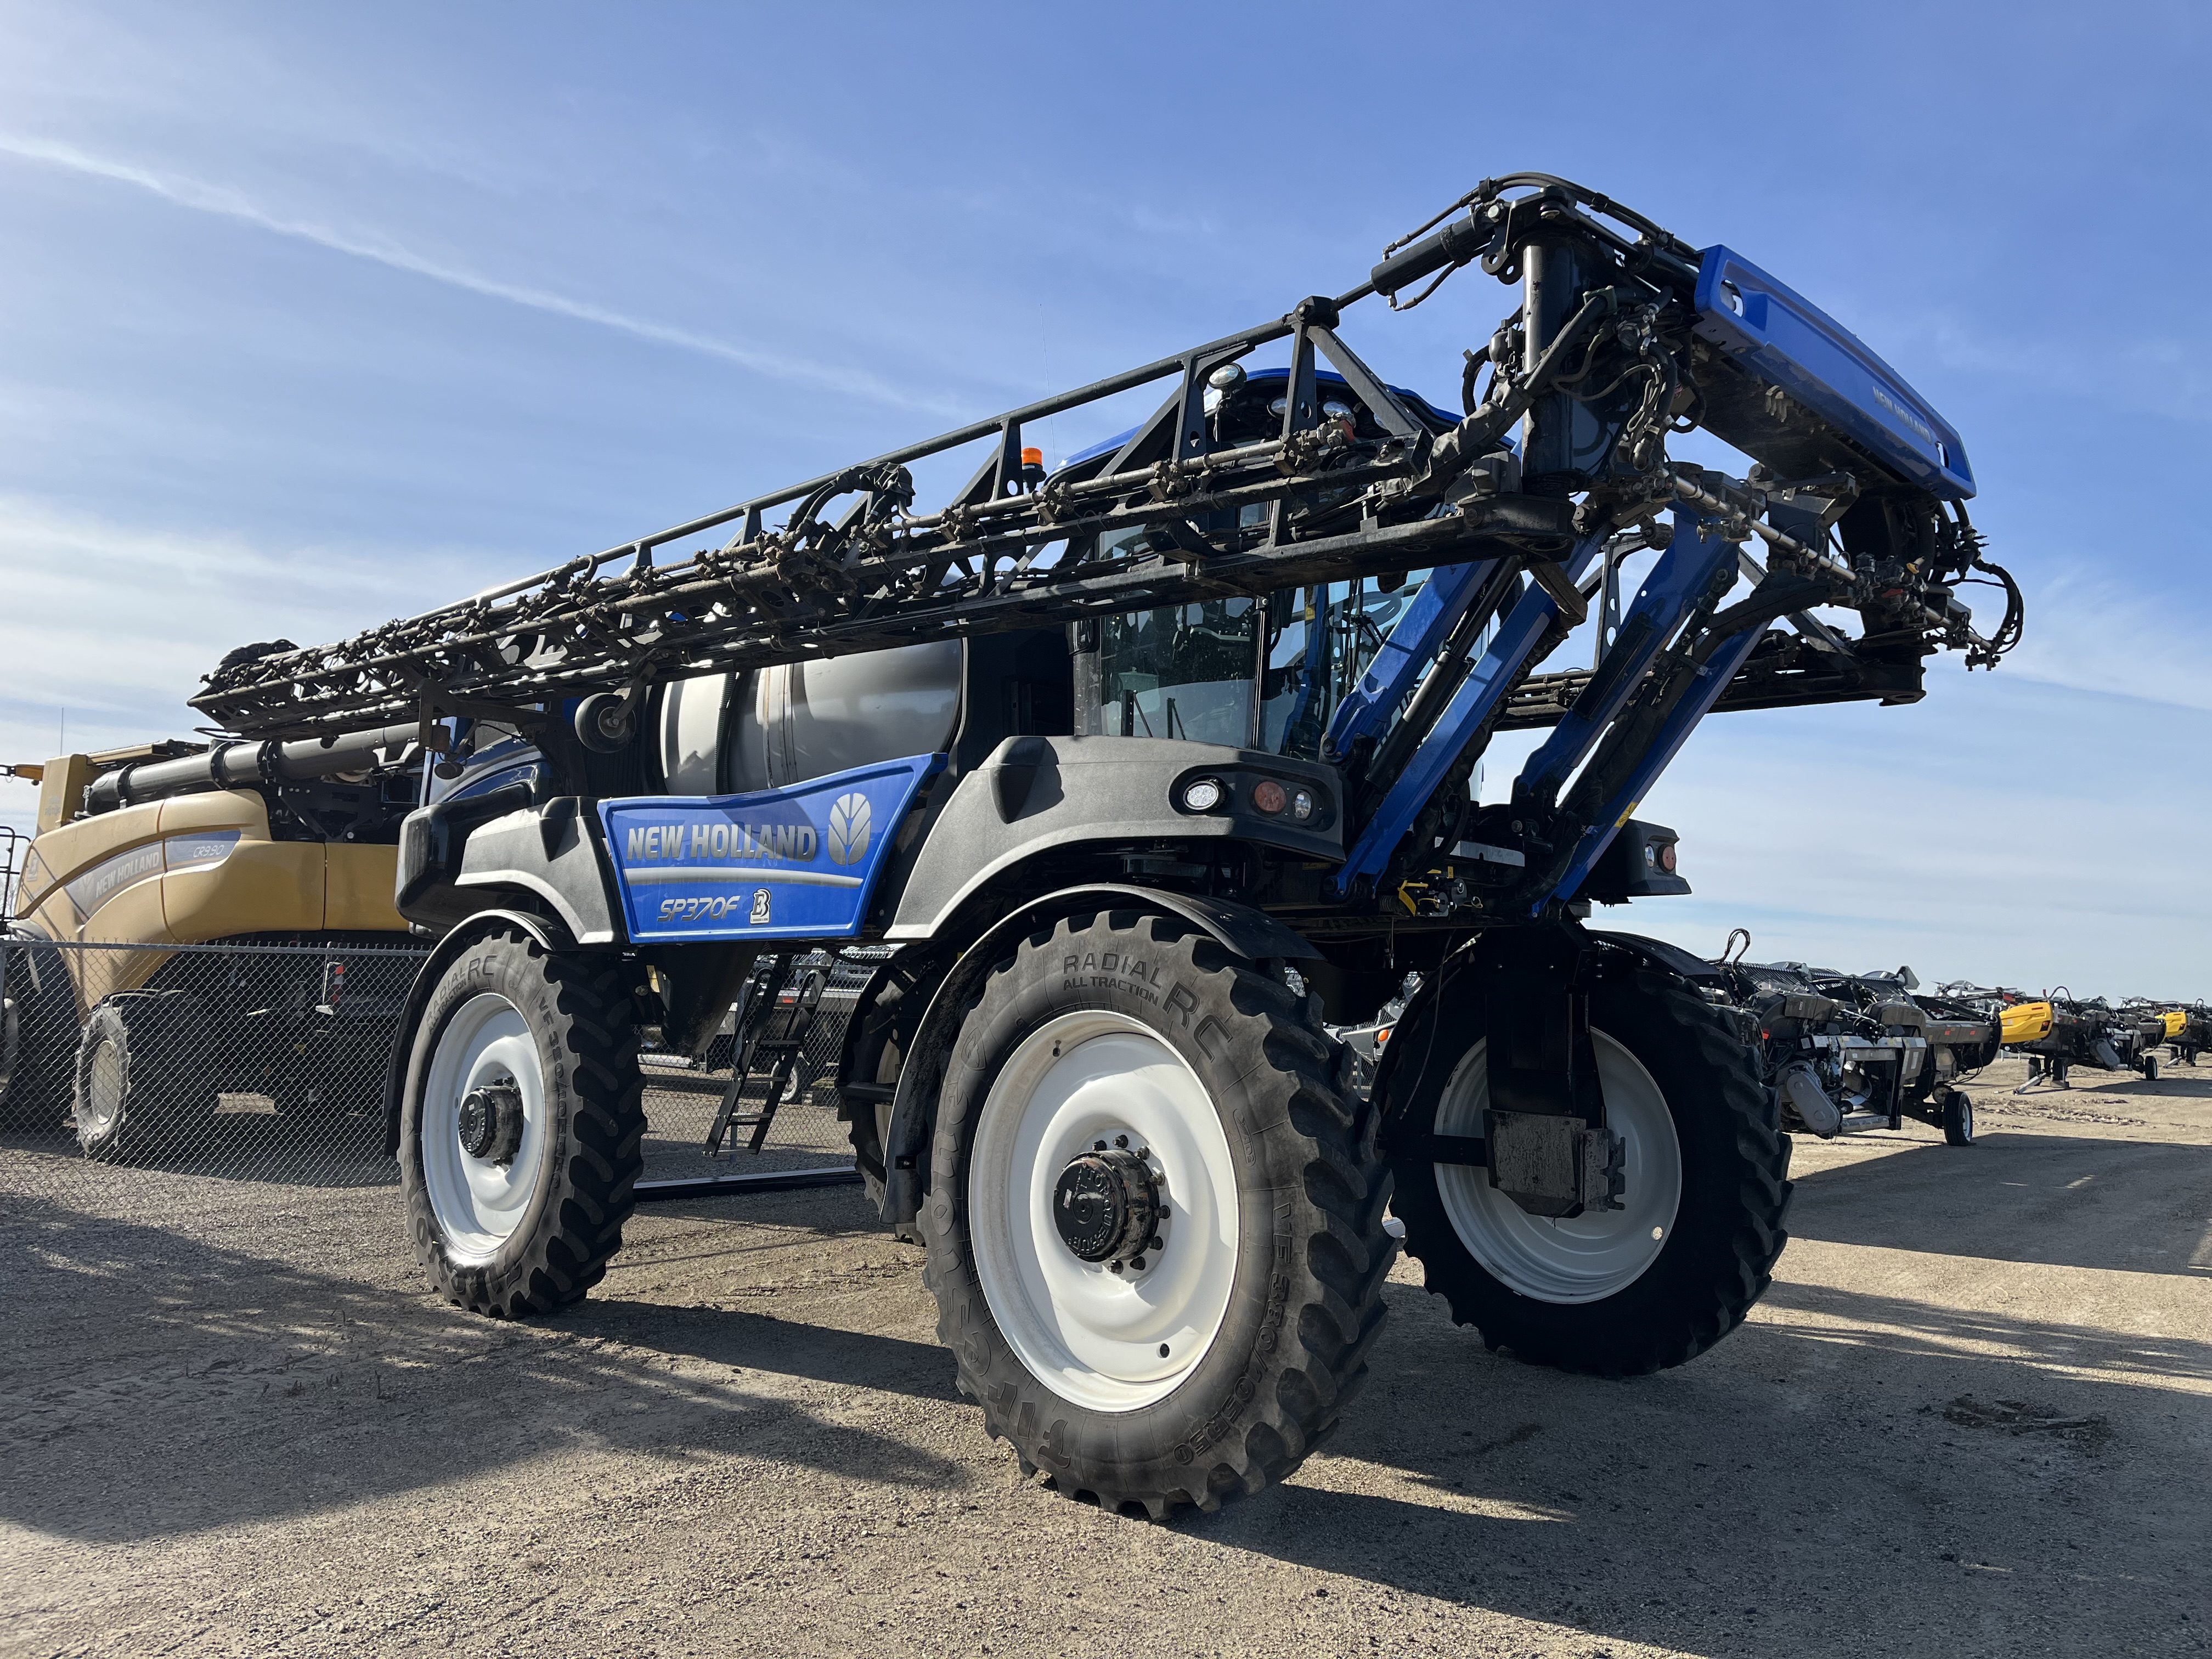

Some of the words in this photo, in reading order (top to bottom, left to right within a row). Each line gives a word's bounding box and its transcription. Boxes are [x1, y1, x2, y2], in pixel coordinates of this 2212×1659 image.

[1872, 386, 1893, 414] NEW
[193, 845, 224, 858] CR9.90
[627, 825, 685, 861] NEW
[691, 824, 817, 862] HOLLAND
[95, 870, 118, 898] NEW
[117, 851, 160, 884] HOLLAND
[657, 895, 741, 922] SP370F
[467, 954, 498, 983] RC
[1063, 952, 1161, 990] RADIAL
[426, 967, 466, 1026] RADIAL
[428, 1016, 439, 1035] ALL
[437, 979, 467, 1015] TRACTION
[1063, 977, 1087, 991] ALL
[1090, 976, 1159, 1006] TRACTION
[538, 996, 554, 1026] VF
[1162, 980, 1233, 1063] RC
[1273, 1202, 1291, 1264] VF
[930, 1082, 1071, 1469] Firestone
[1172, 1272, 1291, 1466] 380/105R50
